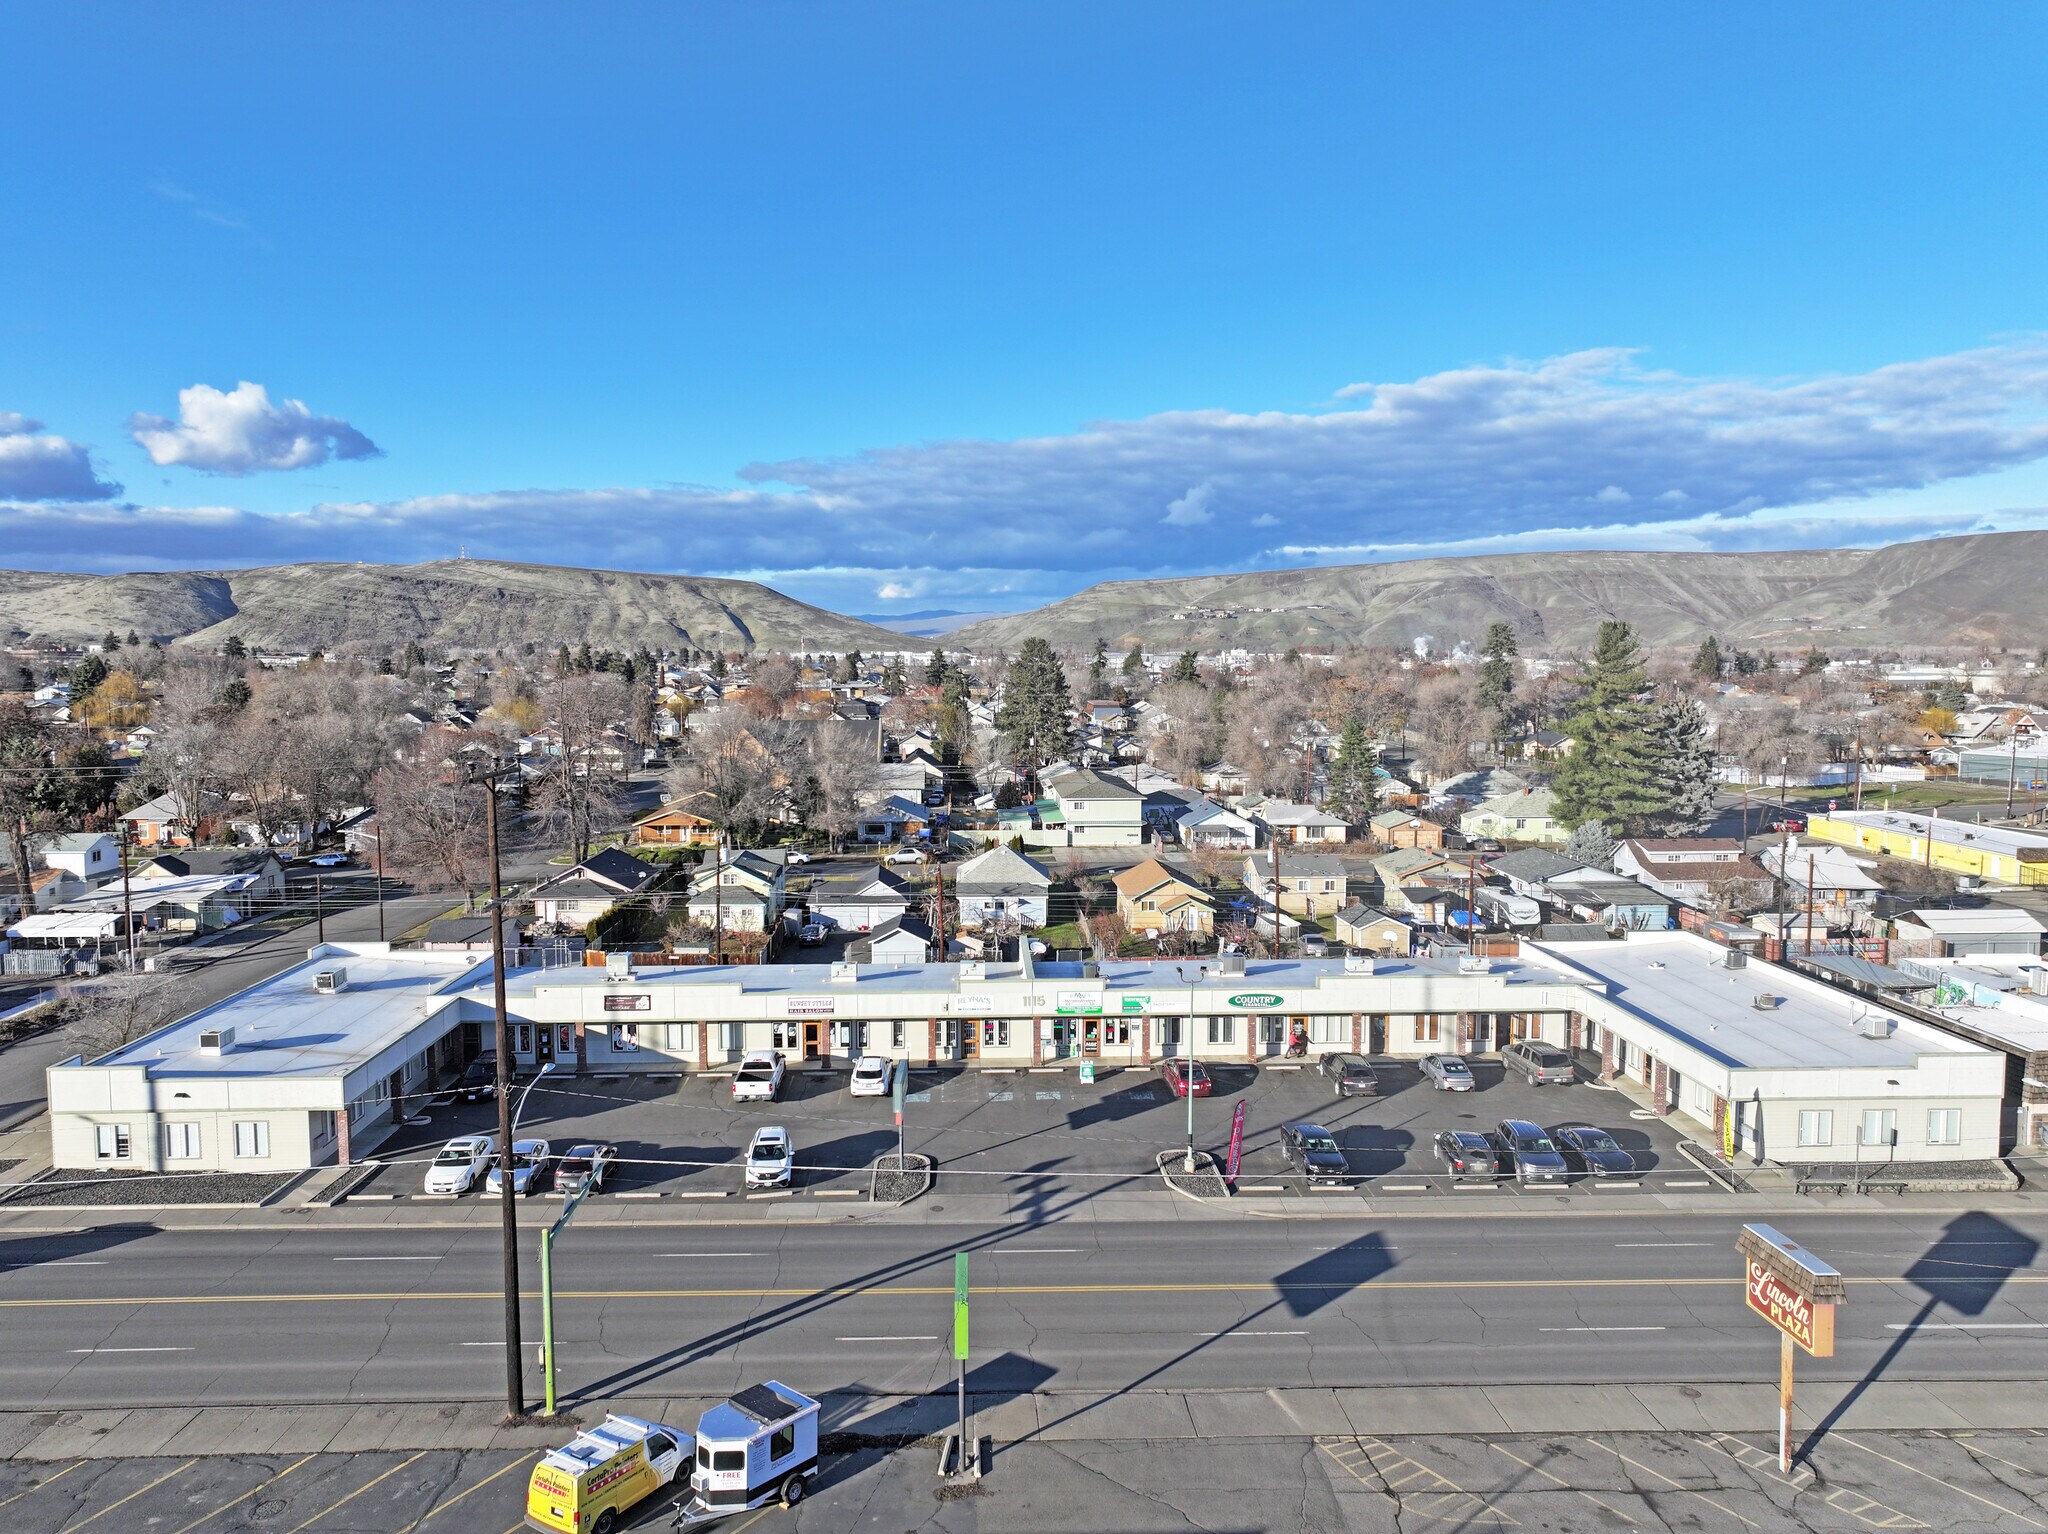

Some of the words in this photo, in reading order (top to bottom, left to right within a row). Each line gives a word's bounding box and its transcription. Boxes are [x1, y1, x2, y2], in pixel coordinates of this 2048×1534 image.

[958, 996, 991, 1005] REYNA'S
[1022, 995, 1046, 1007] 1115
[1235, 996, 1276, 1004] COUNTRY
[1749, 1262, 1810, 1325] Lincoln
[1770, 1301, 1811, 1345] PLAZA
[587, 1467, 613, 1486] CertaPro
[614, 1452, 639, 1471] Painters
[722, 1471, 741, 1479] FREE
